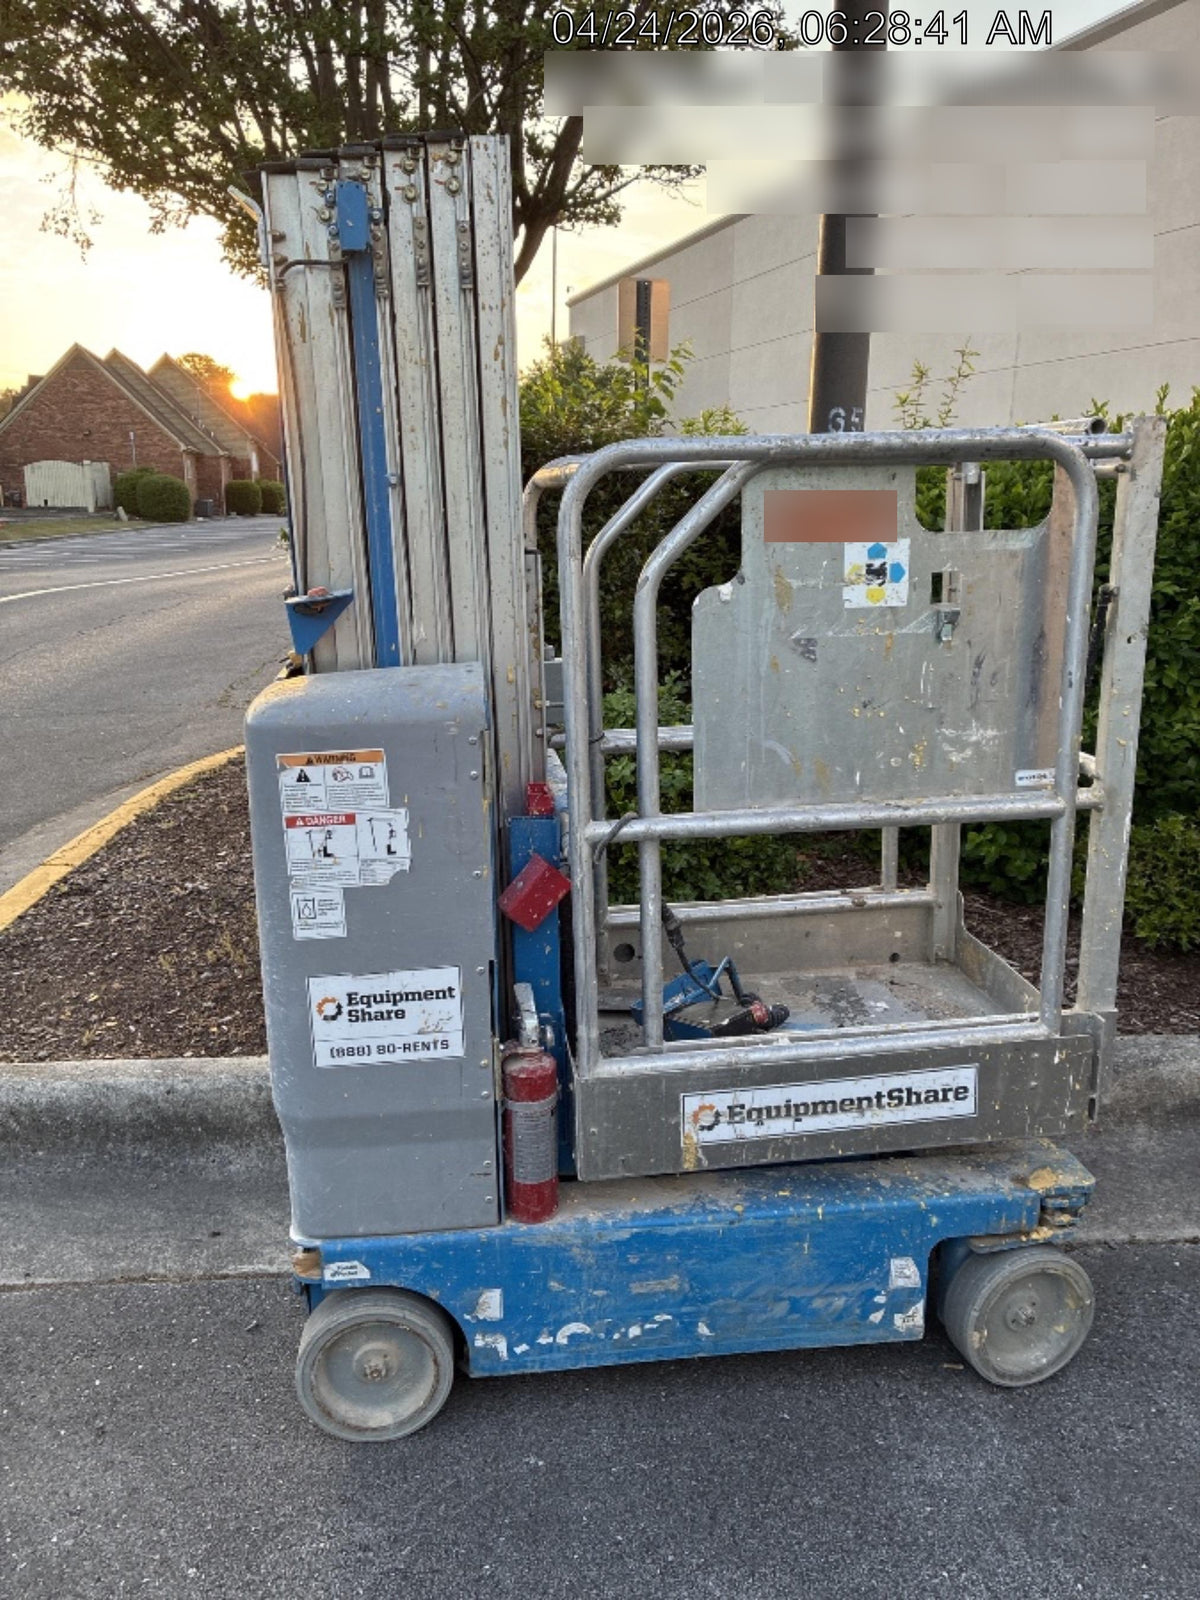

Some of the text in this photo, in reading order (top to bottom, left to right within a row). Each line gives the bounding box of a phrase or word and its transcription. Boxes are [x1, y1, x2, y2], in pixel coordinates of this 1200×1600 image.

[315, 753, 356, 764] WARNING
[305, 815, 346, 826] DANGER
[346, 985, 456, 1008] Equipment
[347, 1008, 406, 1023] Share
[330, 1039, 449, 1059] (888) 80-RENTS
[726, 1084, 969, 1126] EquipmentShare
